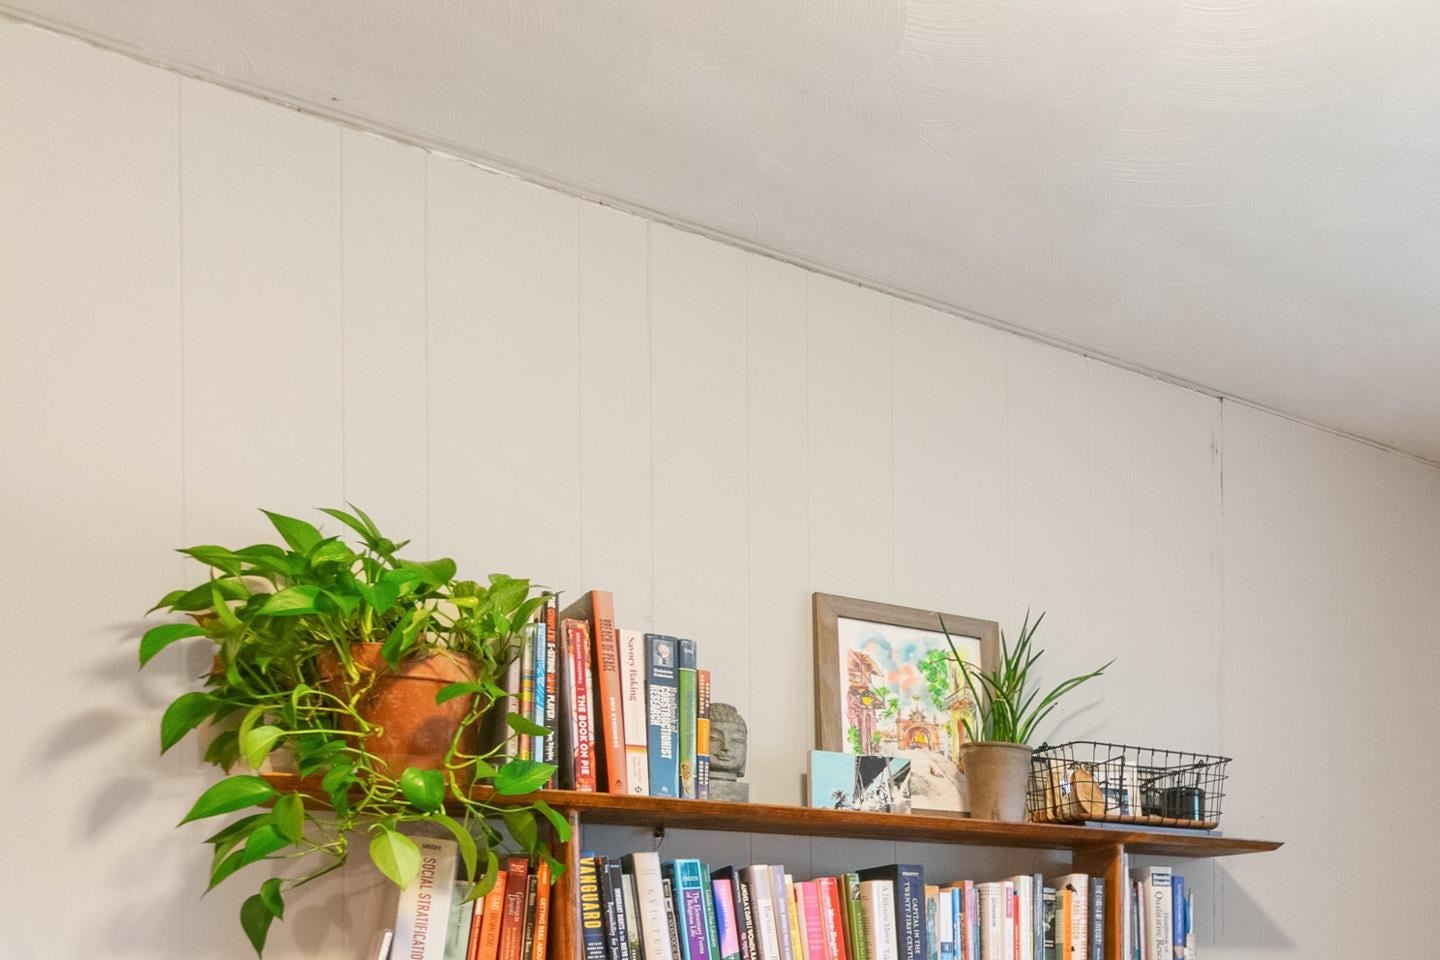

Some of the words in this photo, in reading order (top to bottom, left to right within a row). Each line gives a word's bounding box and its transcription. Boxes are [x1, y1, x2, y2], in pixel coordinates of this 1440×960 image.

[627, 636, 638, 667] Savory
[628, 669, 639, 702] Baking
[576, 695, 586, 712] THE
[650, 684, 662, 726] RESEARCH
[578, 714, 588, 743] BOOK
[660, 686, 672, 759] CONSTRUCTIONIST
[580, 743, 589, 757] ON
[581, 760, 590, 775] PIE
[419, 857, 437, 890] SOCIAL
[580, 857, 602, 929] VANGUARD
[692, 891, 700, 904] The
[741, 883, 749, 906] ANGELA
[903, 881, 913, 935] TWENTY-FIRST
[539, 897, 547, 924] GETTING
[607, 901, 617, 936] Responsibility
[647, 889, 661, 956] EVICTED
[686, 899, 695, 925] Religious
[692, 904, 704, 935] Elementary
[911, 897, 920, 928] CAPITAL
[1154, 890, 1163, 938] Qualitative
[537, 925, 545, 942] REAL
[697, 936, 706, 954] Forms
[913, 929, 920, 938] IN
